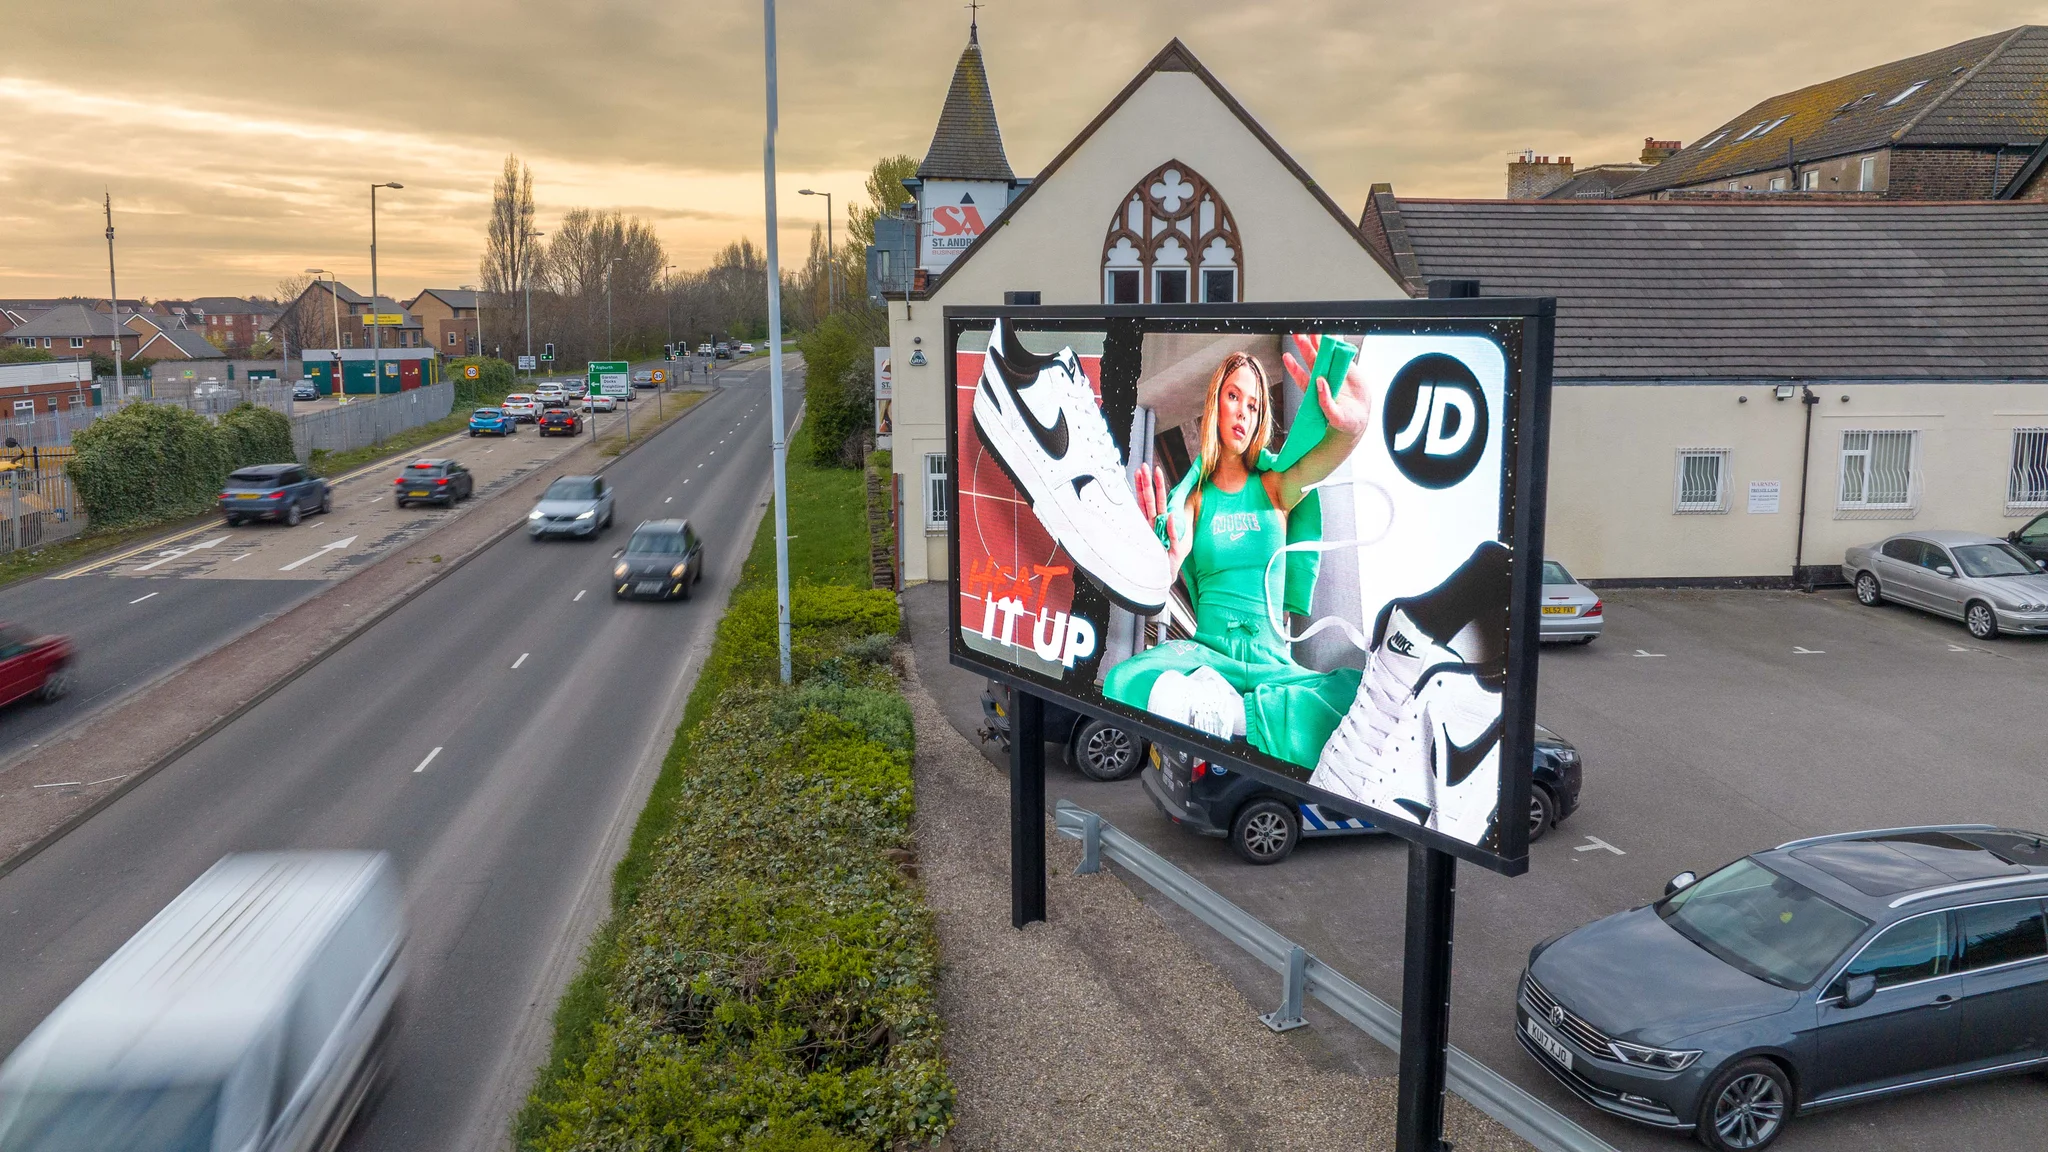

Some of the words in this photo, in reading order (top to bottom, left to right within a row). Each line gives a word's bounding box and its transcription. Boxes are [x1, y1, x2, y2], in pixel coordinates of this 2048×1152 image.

[932, 238, 945, 247] ST.
[947, 238, 977, 247] ANDR
[1393, 385, 1476, 456] JD
[968, 555, 1070, 623] HEAT
[982, 591, 1025, 648] IT
[1032, 607, 1096, 669] UP
[1391, 630, 1415, 652] NIKE
